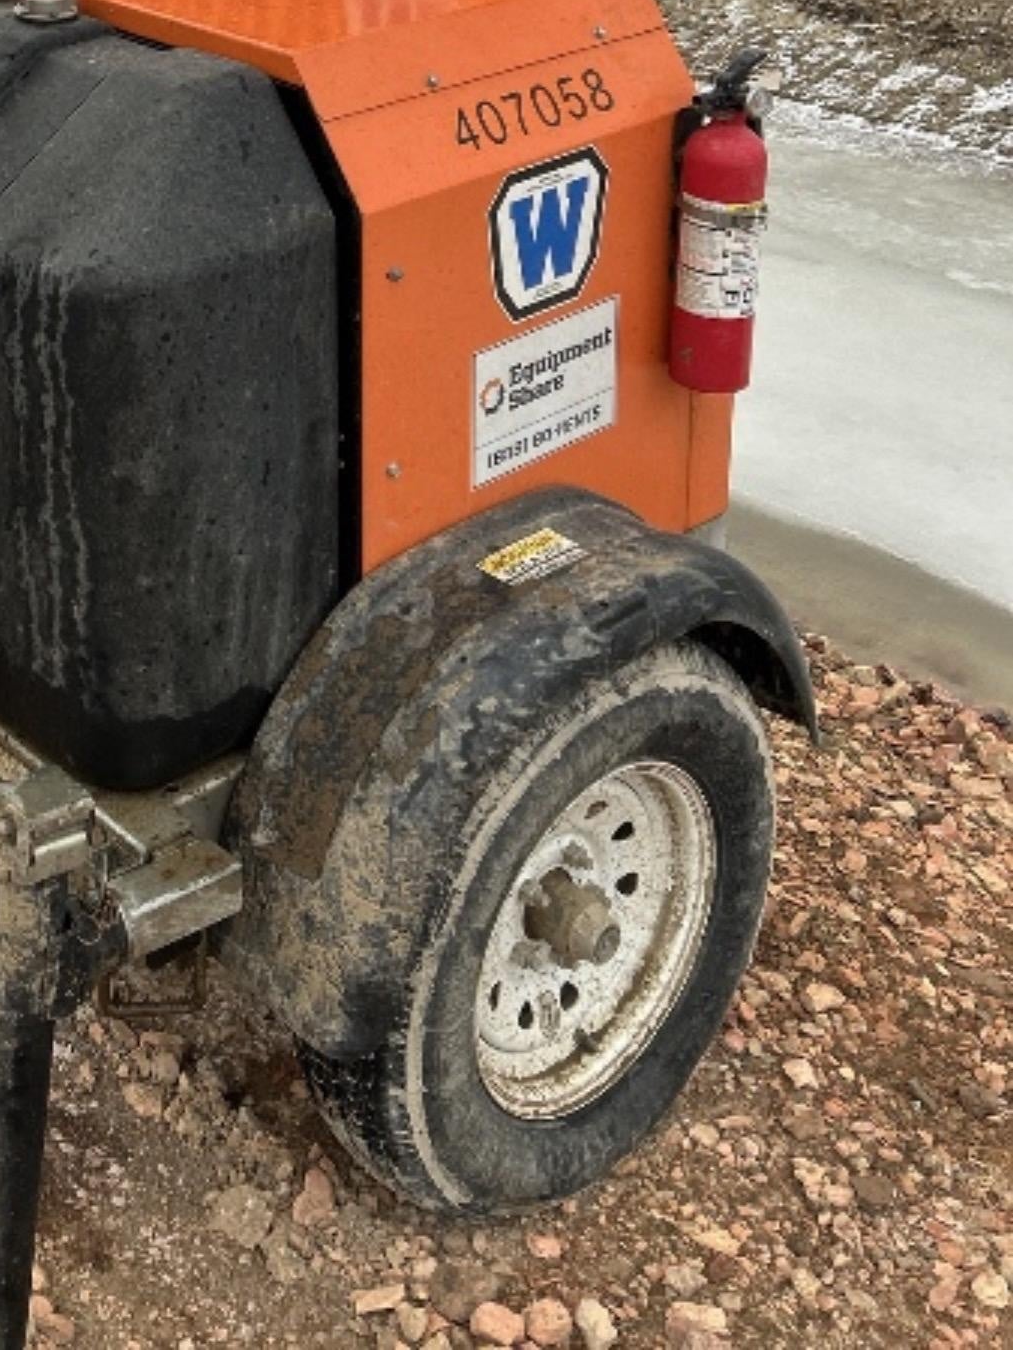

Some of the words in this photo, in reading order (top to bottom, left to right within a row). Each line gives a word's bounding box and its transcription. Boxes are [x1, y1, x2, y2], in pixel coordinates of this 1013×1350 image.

[455, 68, 615, 150] 407058
[509, 175, 591, 292] W
[508, 326, 613, 388] Equipment
[508, 373, 566, 412] Share
